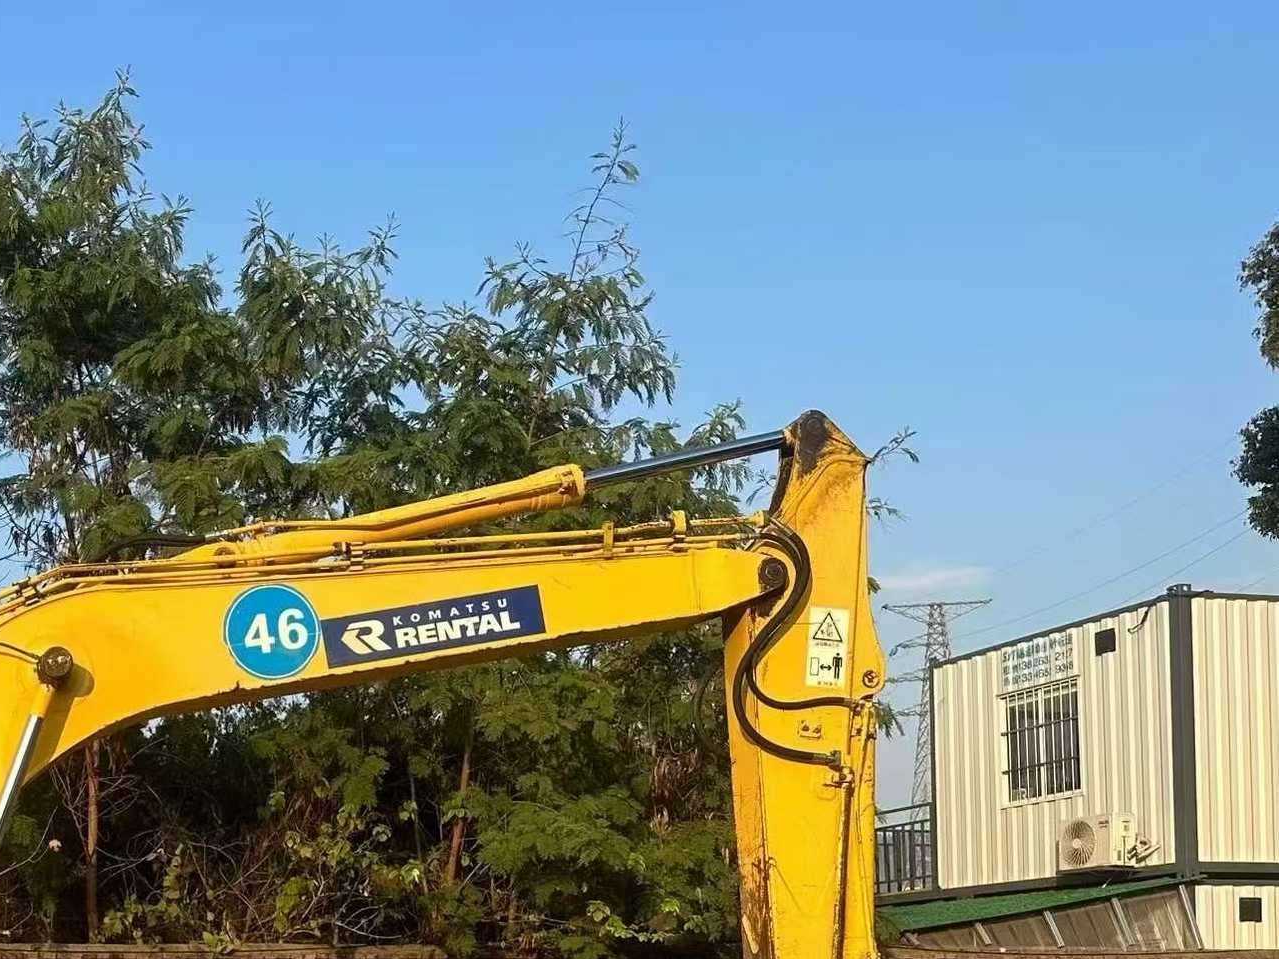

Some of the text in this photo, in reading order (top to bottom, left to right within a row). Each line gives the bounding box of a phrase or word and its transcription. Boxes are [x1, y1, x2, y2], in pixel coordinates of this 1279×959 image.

[244, 608, 308, 653] 46
[392, 598, 508, 627] KOMATSU
[394, 610, 521, 649] RENTAL
